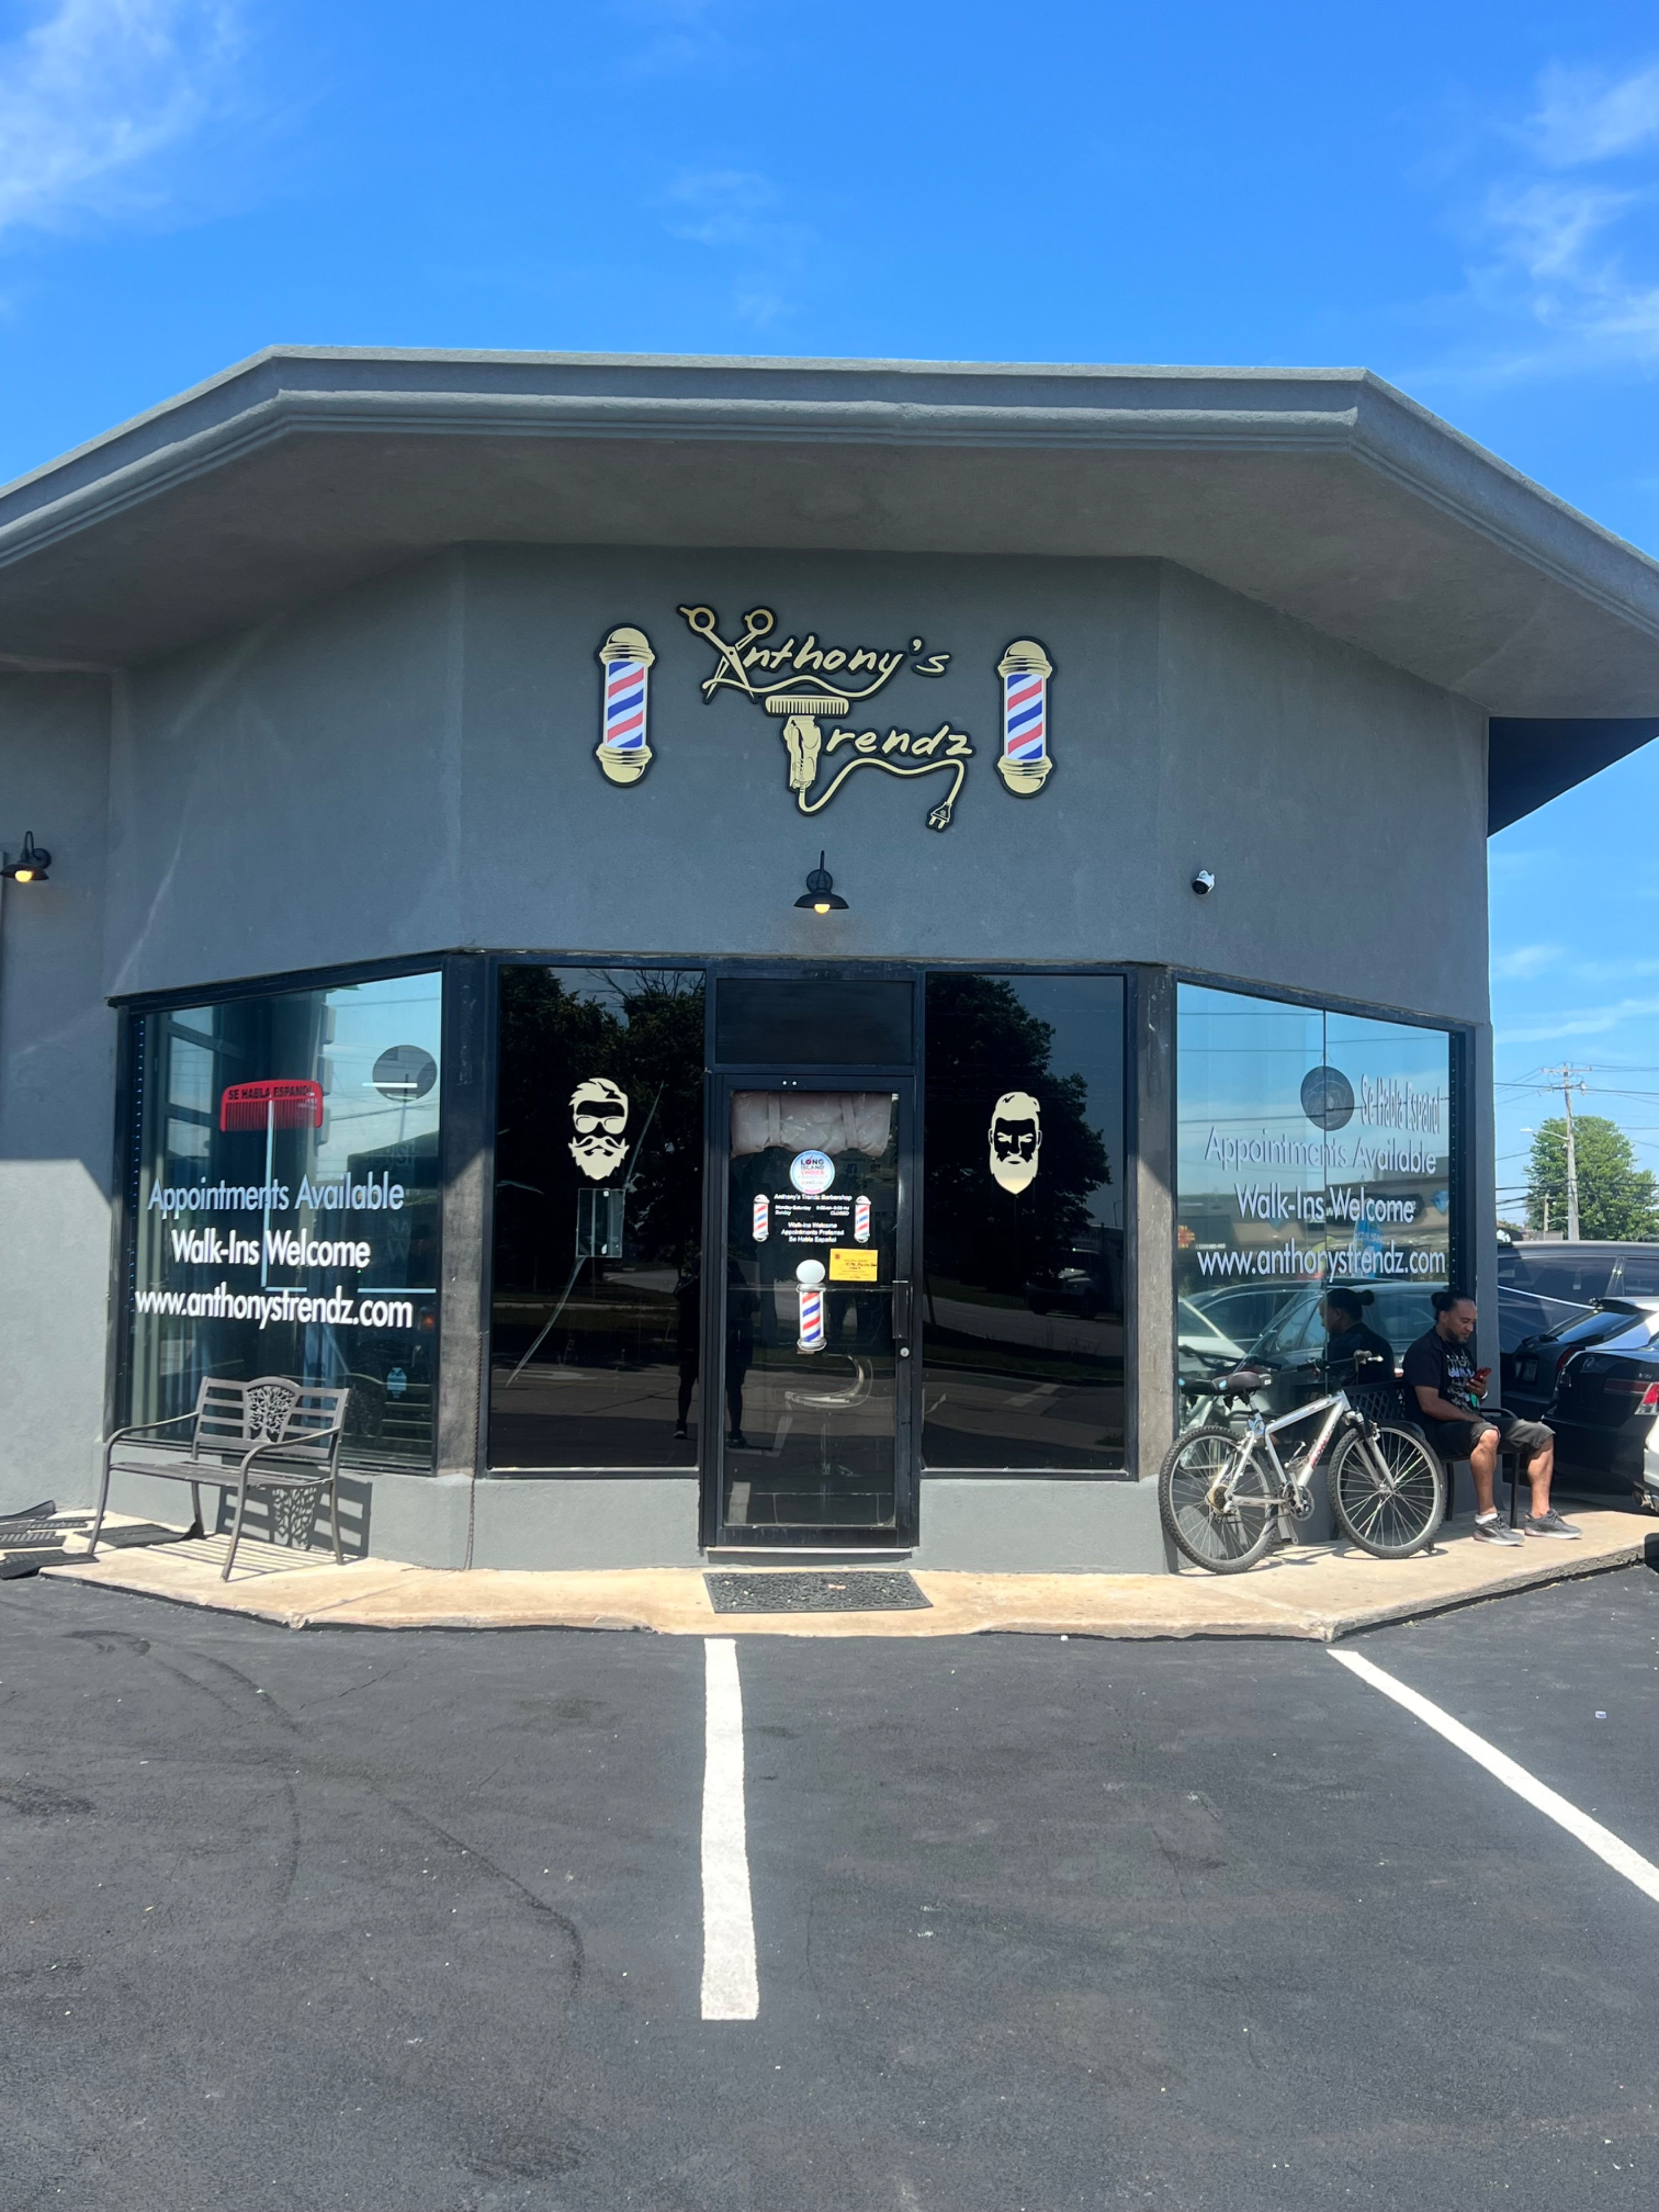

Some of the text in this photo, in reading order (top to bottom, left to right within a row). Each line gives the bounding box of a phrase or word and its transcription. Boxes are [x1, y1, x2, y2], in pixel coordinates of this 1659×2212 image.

[681, 607, 950, 702] Anthony's
[228, 1089, 239, 1100] SE
[242, 1087, 270, 1099] HABLA
[1361, 1074, 1373, 1125] Se
[1376, 1077, 1404, 1129] Habla
[1204, 1125, 1437, 1174] Appointments Available
[147, 1170, 405, 1219] Appointments Available
[1234, 1182, 1415, 1223] Walk-Ins Welcome
[171, 1227, 259, 1265] Walk-Ins
[265, 1227, 371, 1268] Welcome
[1197, 1238, 1446, 1283] www.anthonystrendz.com
[135, 1281, 414, 1329] www.anthonystrendz.com
